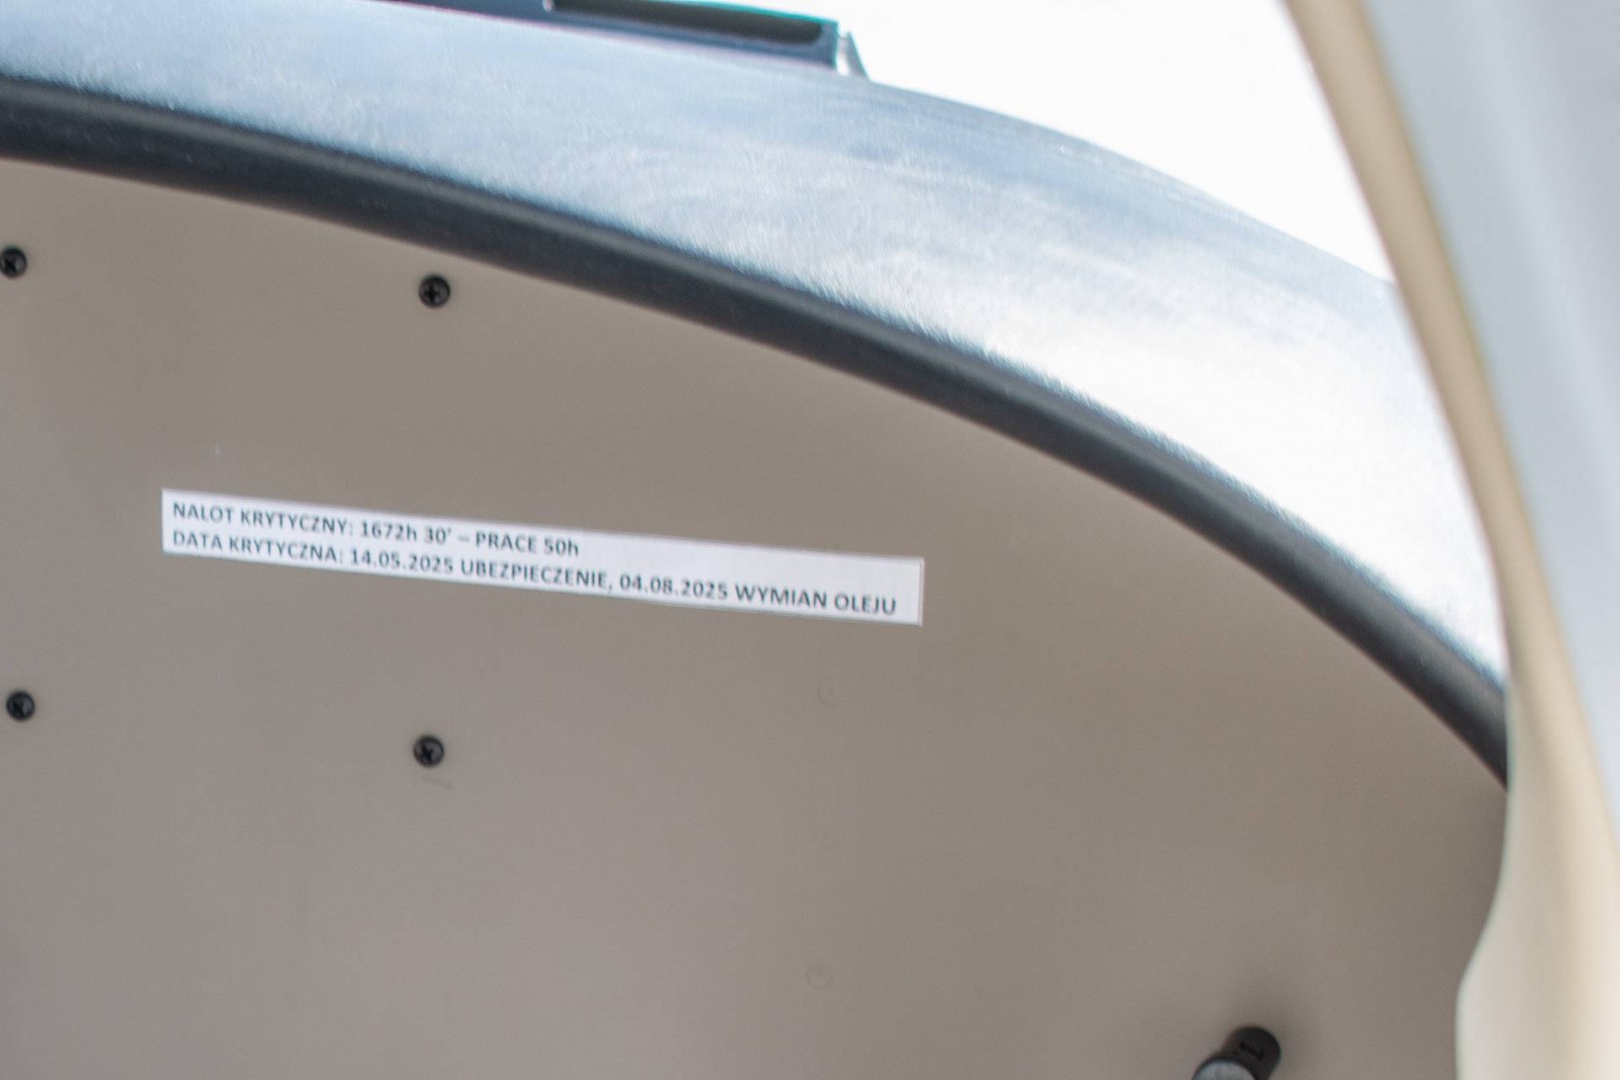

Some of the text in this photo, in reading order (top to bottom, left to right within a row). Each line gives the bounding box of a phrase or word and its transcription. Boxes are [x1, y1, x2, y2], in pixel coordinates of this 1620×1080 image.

[174, 502, 234, 525] NALOT
[241, 511, 354, 536] KRYTYCZNY:
[362, 521, 417, 542] 1672h
[475, 532, 537, 553] PRACE
[544, 536, 579, 556] 50h
[174, 531, 897, 615] DATA KRYTYCZNA: 14.05.2025 UBEZPIECZENIE, 04.08.2025 WYMIAN OLEJU
